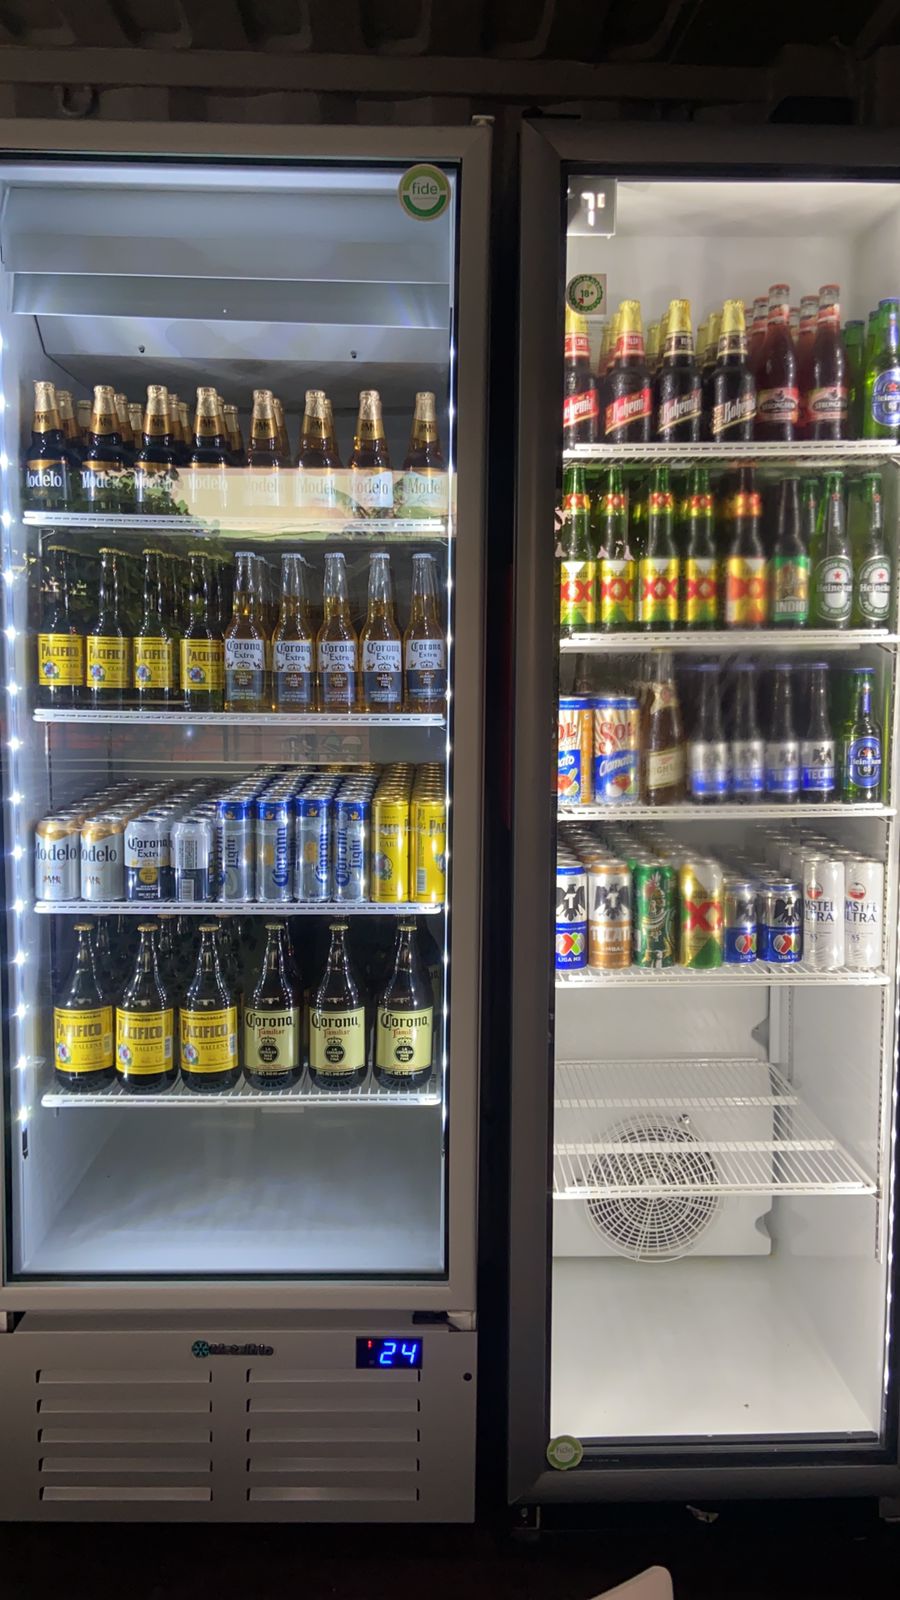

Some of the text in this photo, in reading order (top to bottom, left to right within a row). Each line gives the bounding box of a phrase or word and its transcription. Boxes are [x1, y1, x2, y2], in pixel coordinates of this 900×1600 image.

[412, 182, 438, 195] fide
[42, 643, 80, 660] PACIFICO
[226, 642, 262, 655] Corona
[233, 651, 255, 659] Extra
[276, 642, 312, 656] Corona
[320, 642, 355, 655] Corona
[366, 642, 400, 655] Corona
[411, 642, 442, 654] Corona
[418, 651, 437, 659] Extra
[285, 653, 305, 661] Extra
[329, 652, 350, 661] Extra
[376, 652, 396, 661] Extra
[80, 844, 117, 862] odelo
[272, 827, 289, 888] Corona
[336, 827, 350, 887] Corona
[349, 839, 363, 870] Light
[804, 911, 834, 922] LTRA
[55, 1016, 102, 1040] PACIFICO
[246, 1012, 293, 1030] Corona
[312, 1012, 361, 1030] Corona
[381, 1012, 429, 1029] Corona
[117, 1018, 163, 1040] PACIFICO
[182, 1018, 228, 1041] PACIFICO
[378, 1342, 417, 1364] 24
